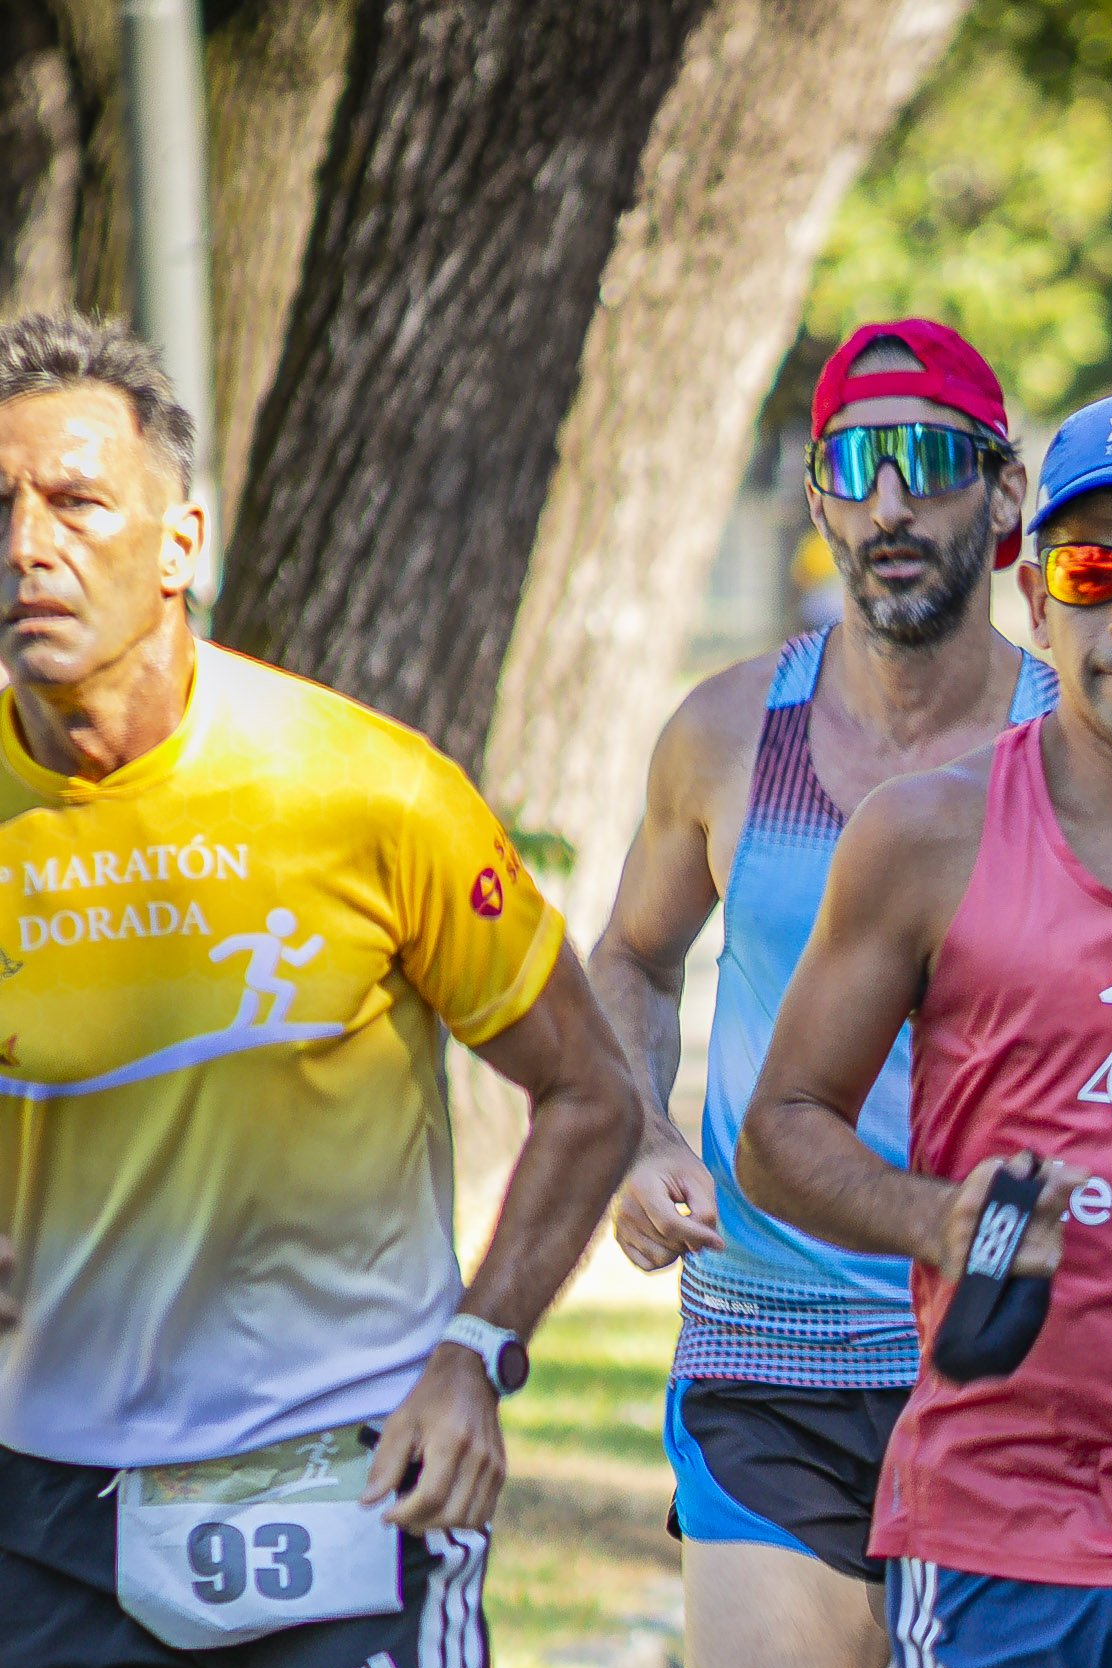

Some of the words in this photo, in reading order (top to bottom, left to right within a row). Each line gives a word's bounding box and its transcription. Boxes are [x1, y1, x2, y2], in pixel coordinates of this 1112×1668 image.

[22, 834, 249, 897] MARATÓN
[18, 901, 212, 952] DORADA
[187, 1522, 313, 1605] 93
